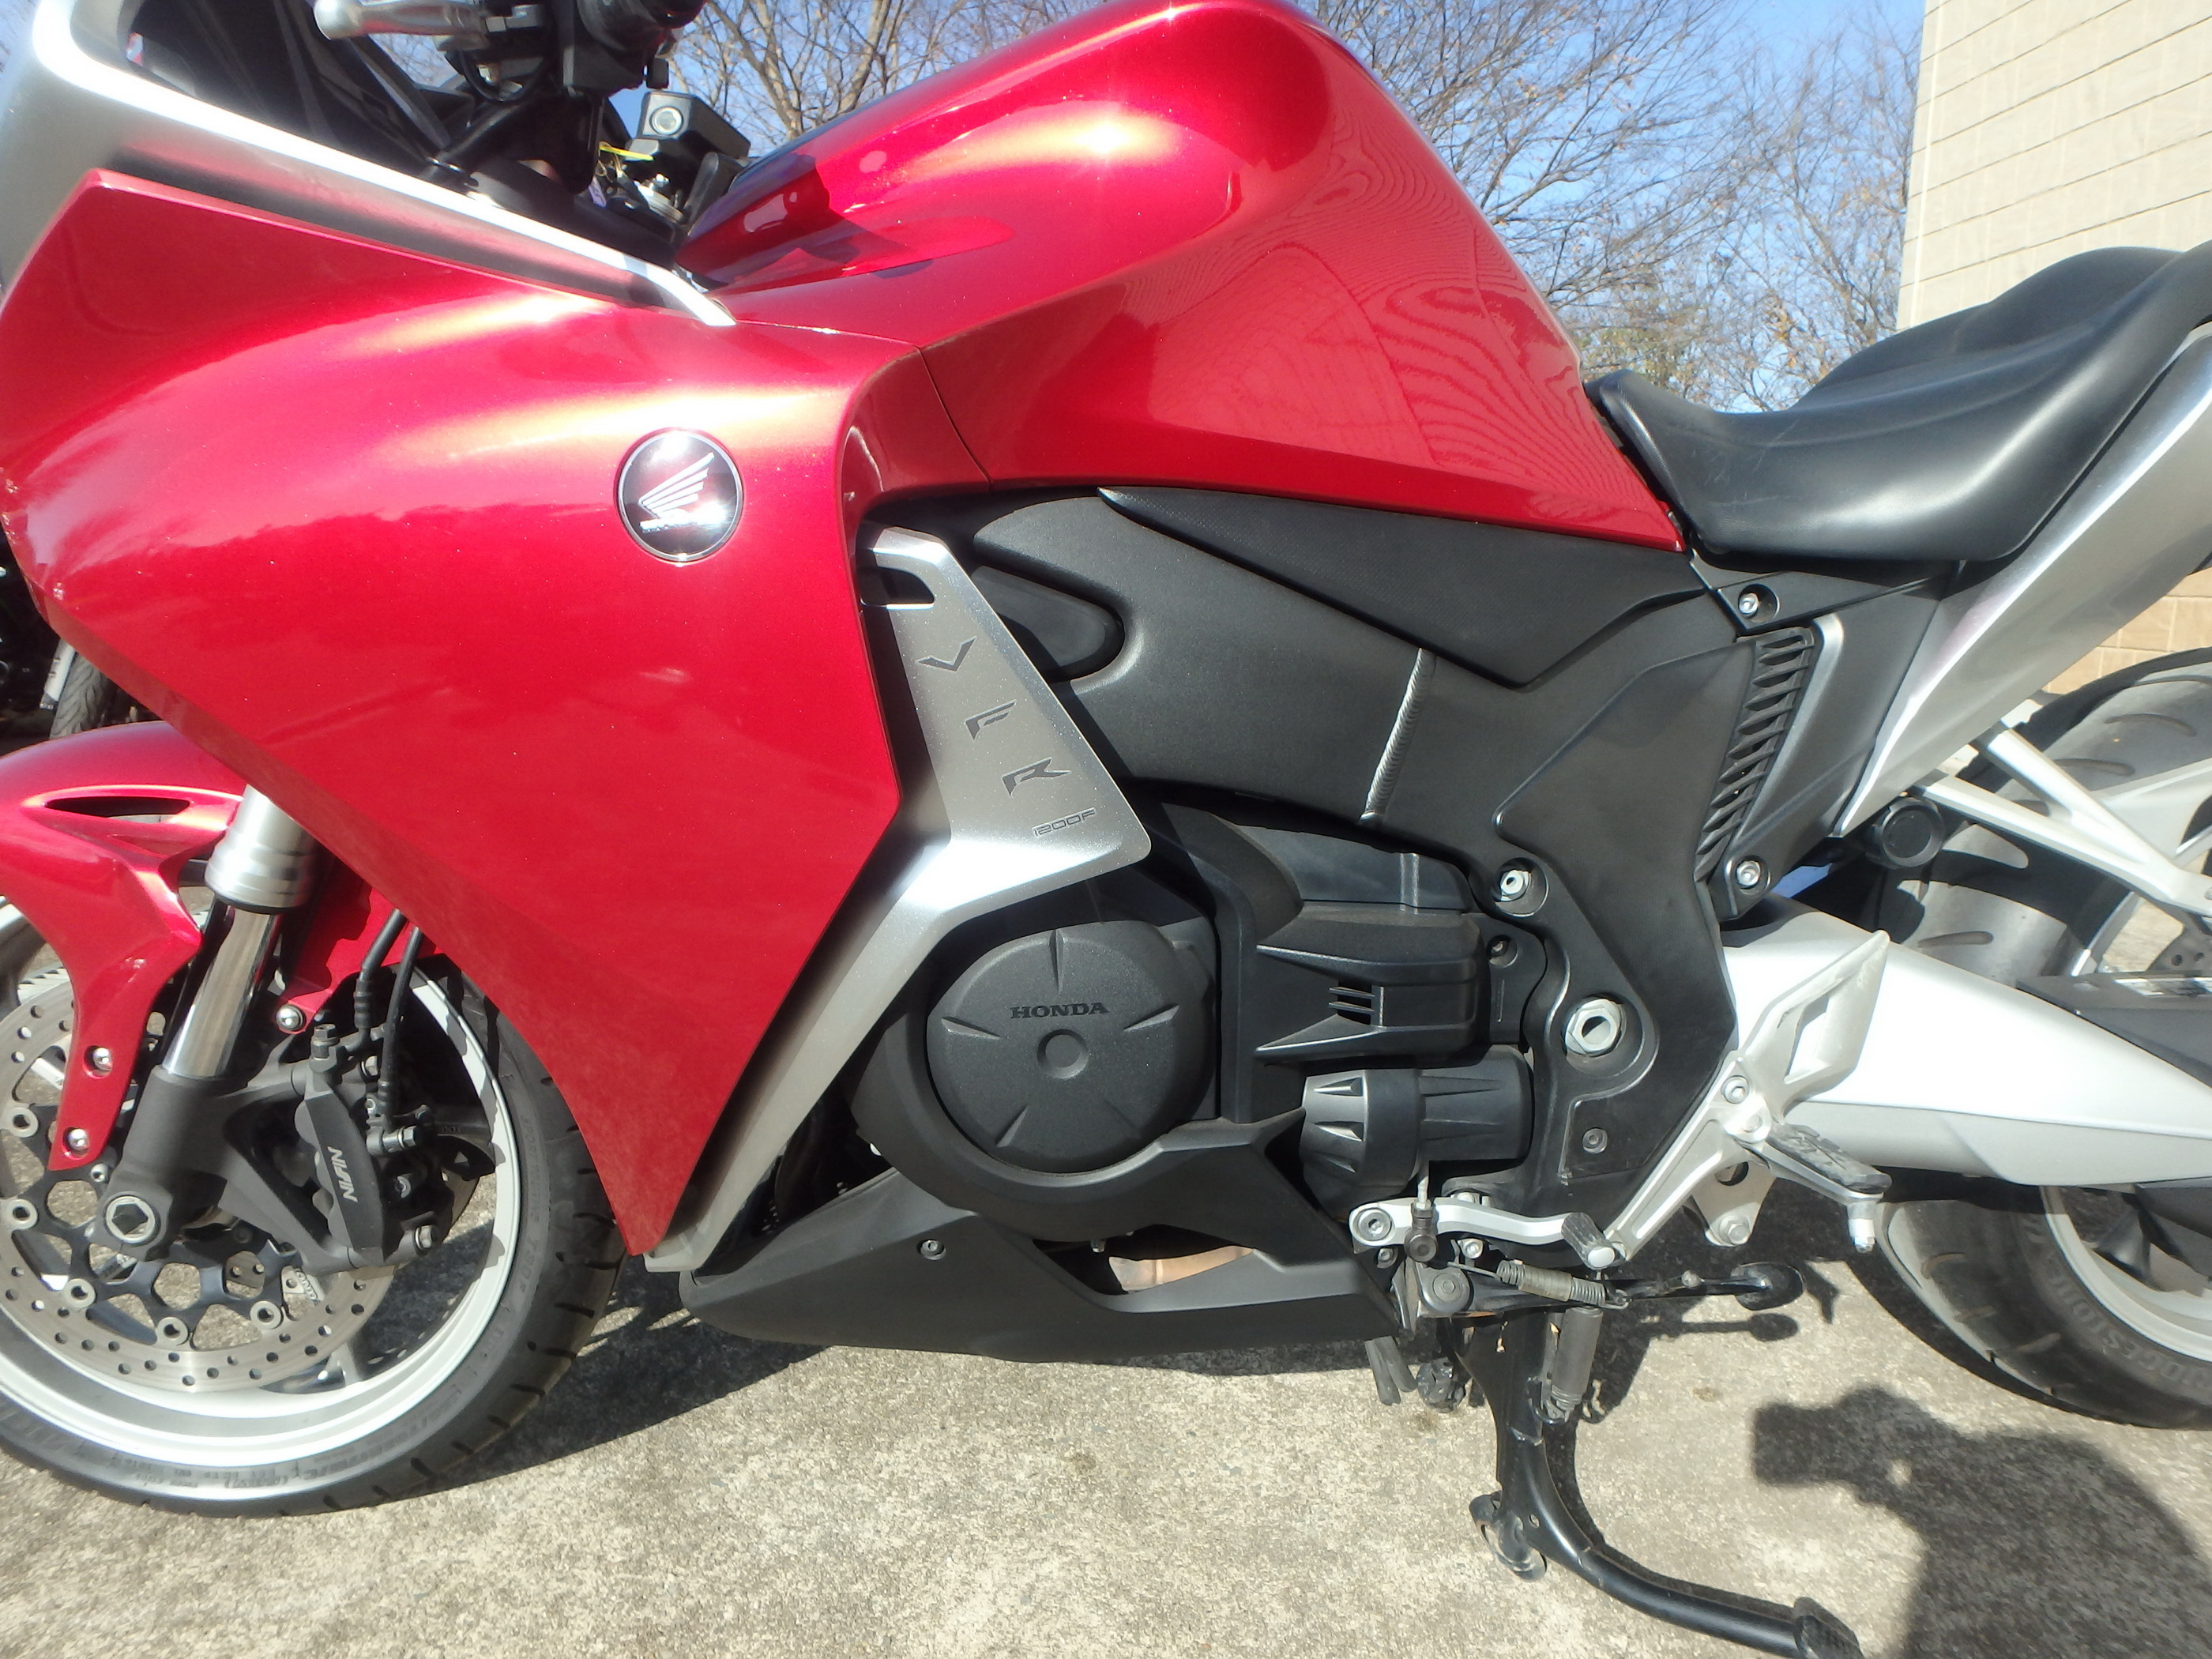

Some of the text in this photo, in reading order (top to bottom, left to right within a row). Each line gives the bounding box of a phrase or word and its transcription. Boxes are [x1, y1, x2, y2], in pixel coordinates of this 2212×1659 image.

[914, 636, 1072, 796] VFR
[1032, 807, 1097, 837] 1200F
[1010, 1002, 1110, 1019] HONDA
